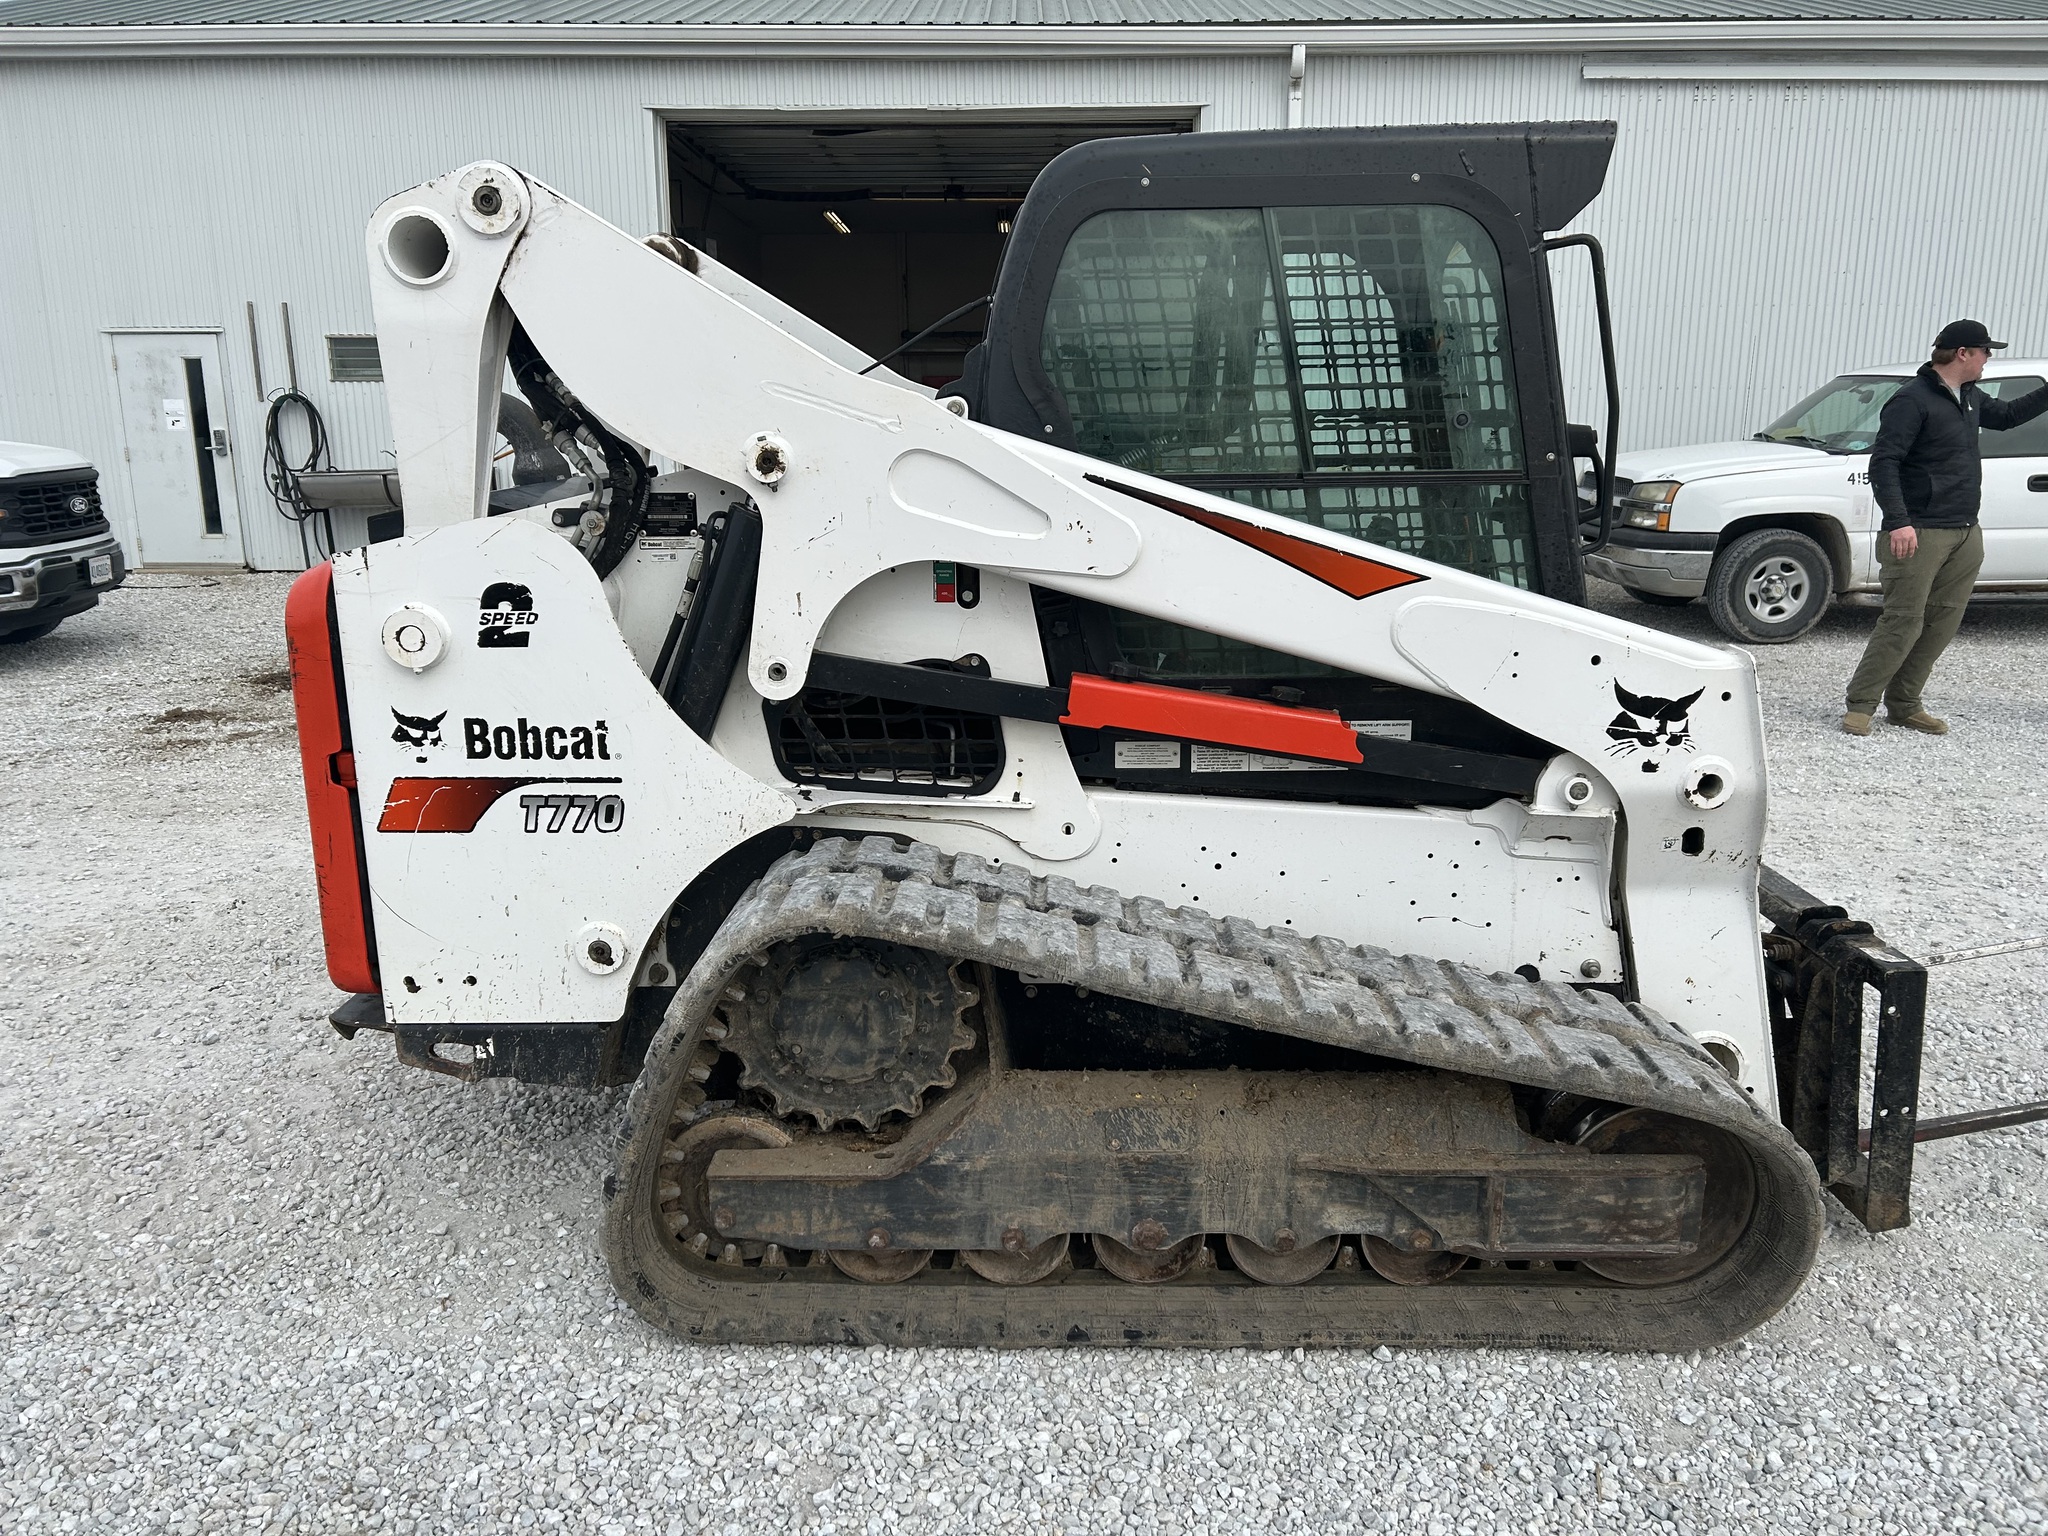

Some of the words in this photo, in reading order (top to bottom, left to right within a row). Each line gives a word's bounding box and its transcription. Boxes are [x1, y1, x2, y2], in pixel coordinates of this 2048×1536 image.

[1847, 472, 1870, 486] 415
[477, 581, 533, 648] 2
[479, 612, 538, 626] SPEED
[463, 717, 611, 760] Bobcat
[520, 794, 625, 834] T770
